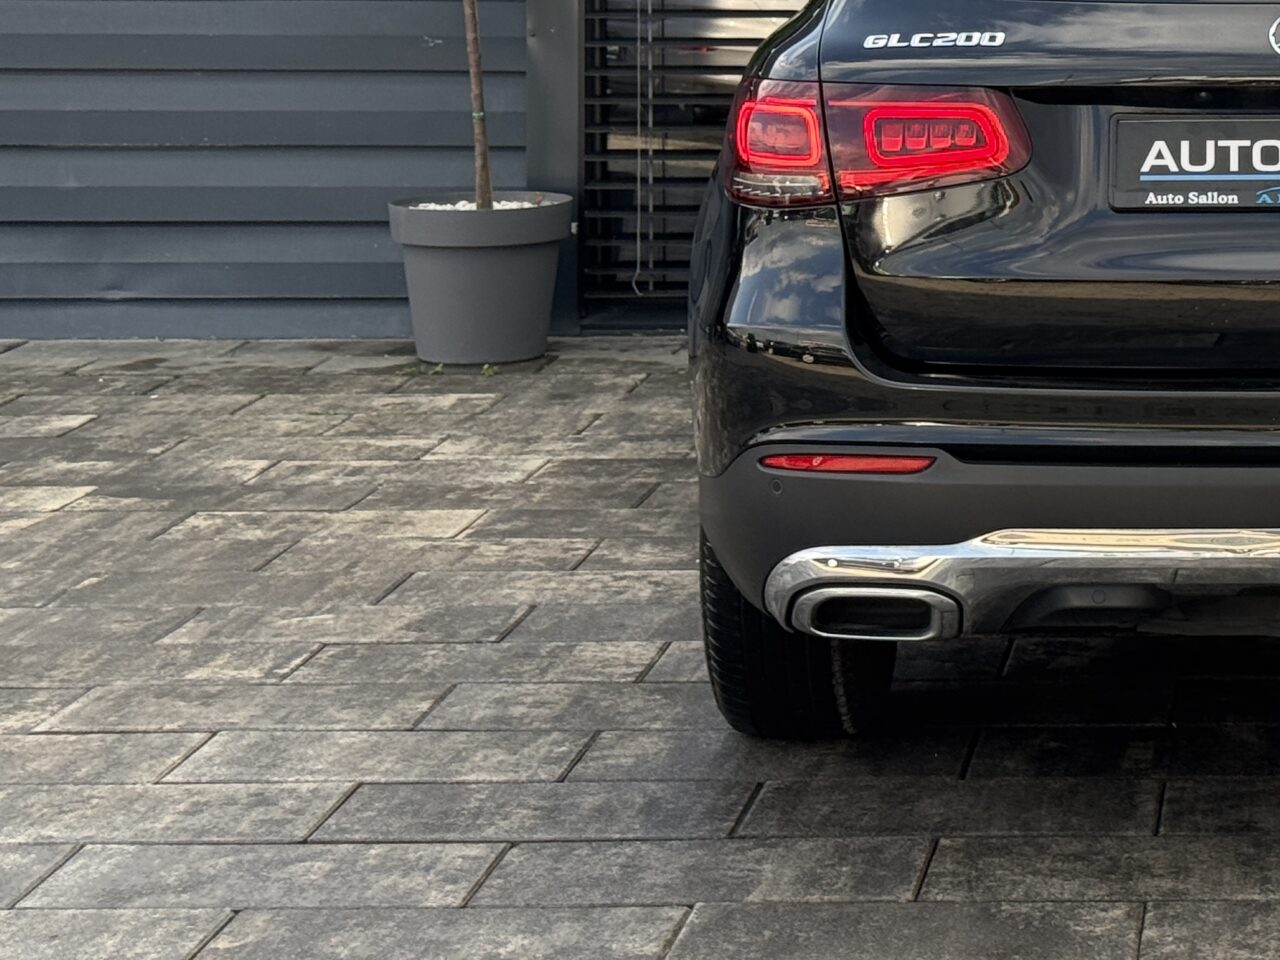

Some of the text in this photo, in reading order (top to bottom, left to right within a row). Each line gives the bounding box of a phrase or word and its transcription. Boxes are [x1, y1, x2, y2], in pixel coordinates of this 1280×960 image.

[863, 31, 1006, 49] GLC200
[1145, 191, 1185, 205] Auto
[1188, 191, 1239, 205] Sallon
